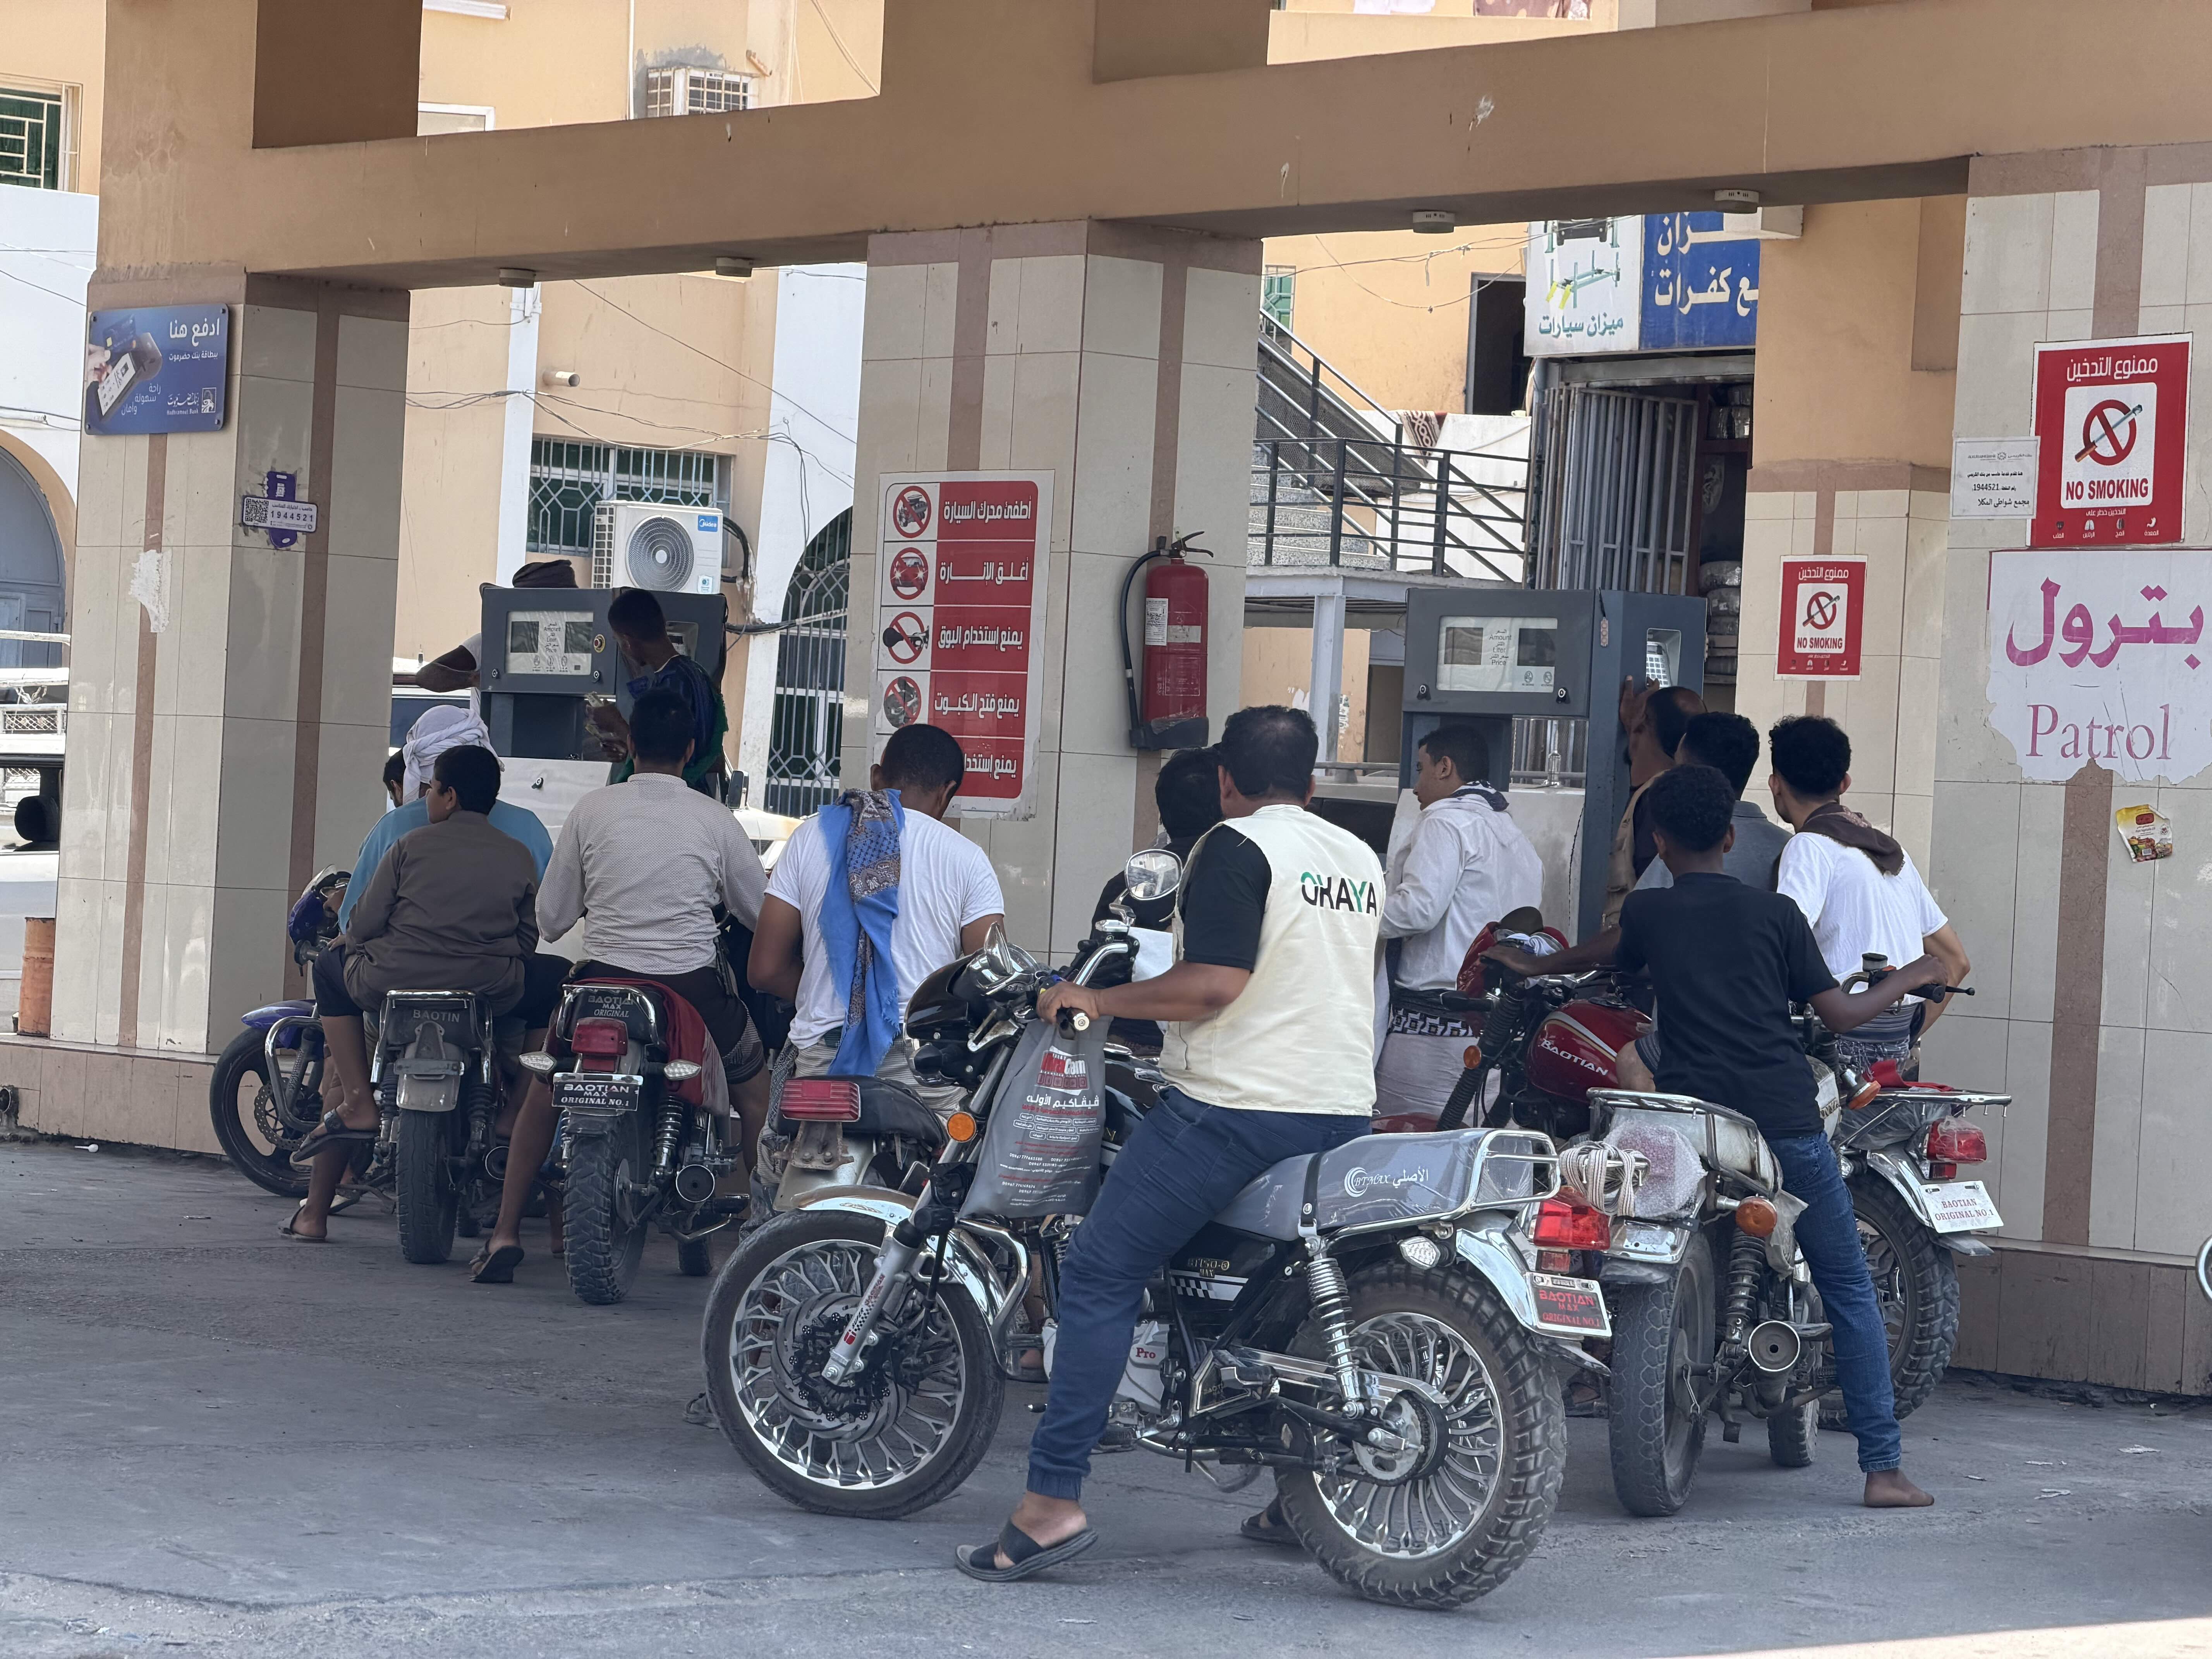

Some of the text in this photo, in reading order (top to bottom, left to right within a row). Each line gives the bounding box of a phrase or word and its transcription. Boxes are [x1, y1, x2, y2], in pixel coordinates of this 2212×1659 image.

[1654, 266, 1732, 314] كفرات
[170, 317, 220, 347] ادفع هنا
[1539, 313, 1624, 339] ميزان سيارات
[169, 352, 191, 362] حضرموت
[191, 352, 200, 361] بنك
[2066, 355, 2158, 382] ممنوع التدخين
[148, 383, 161, 395] راحة
[135, 393, 156, 405] سهولة
[2066, 478, 2149, 501] NO SMOKING
[2013, 500, 2030, 508] مجمع
[944, 501, 976, 524] السيارة
[977, 501, 1002, 524] محرك
[1798, 567, 1849, 580] ممنوع التدخين
[2006, 577, 2204, 670] بترول
[938, 625, 1023, 652] يمنع إستخدام البوق
[1797, 637, 1843, 649] NO SMOKING
[934, 692, 1019, 719] يمنع فتح الكبوت
[2025, 703, 2172, 761] Patrol
[964, 753, 1017, 780] يمنع إستخدا
[1300, 871, 1377, 917] OKAYA
[413, 1009, 460, 1023] BAOTIN
[594, 1009, 629, 1018] ORIGINAL
[1539, 1038, 1608, 1076] BAOTIAN
[564, 1084, 629, 1093] BAOTIAN
[561, 1096, 606, 1105] ORIGINAL
[1393, 1165, 1429, 1188] الأصلي
[1941, 1198, 1977, 1208] BAOTIAN
[1934, 1210, 1975, 1221] ORIGINAL
[1539, 1290, 1595, 1307] BAOTIAN
[1558, 1302, 1579, 1312] MAX
[1542, 1312, 1582, 1325] ORIGINAL
[1135, 1347, 1156, 1358] Pro
